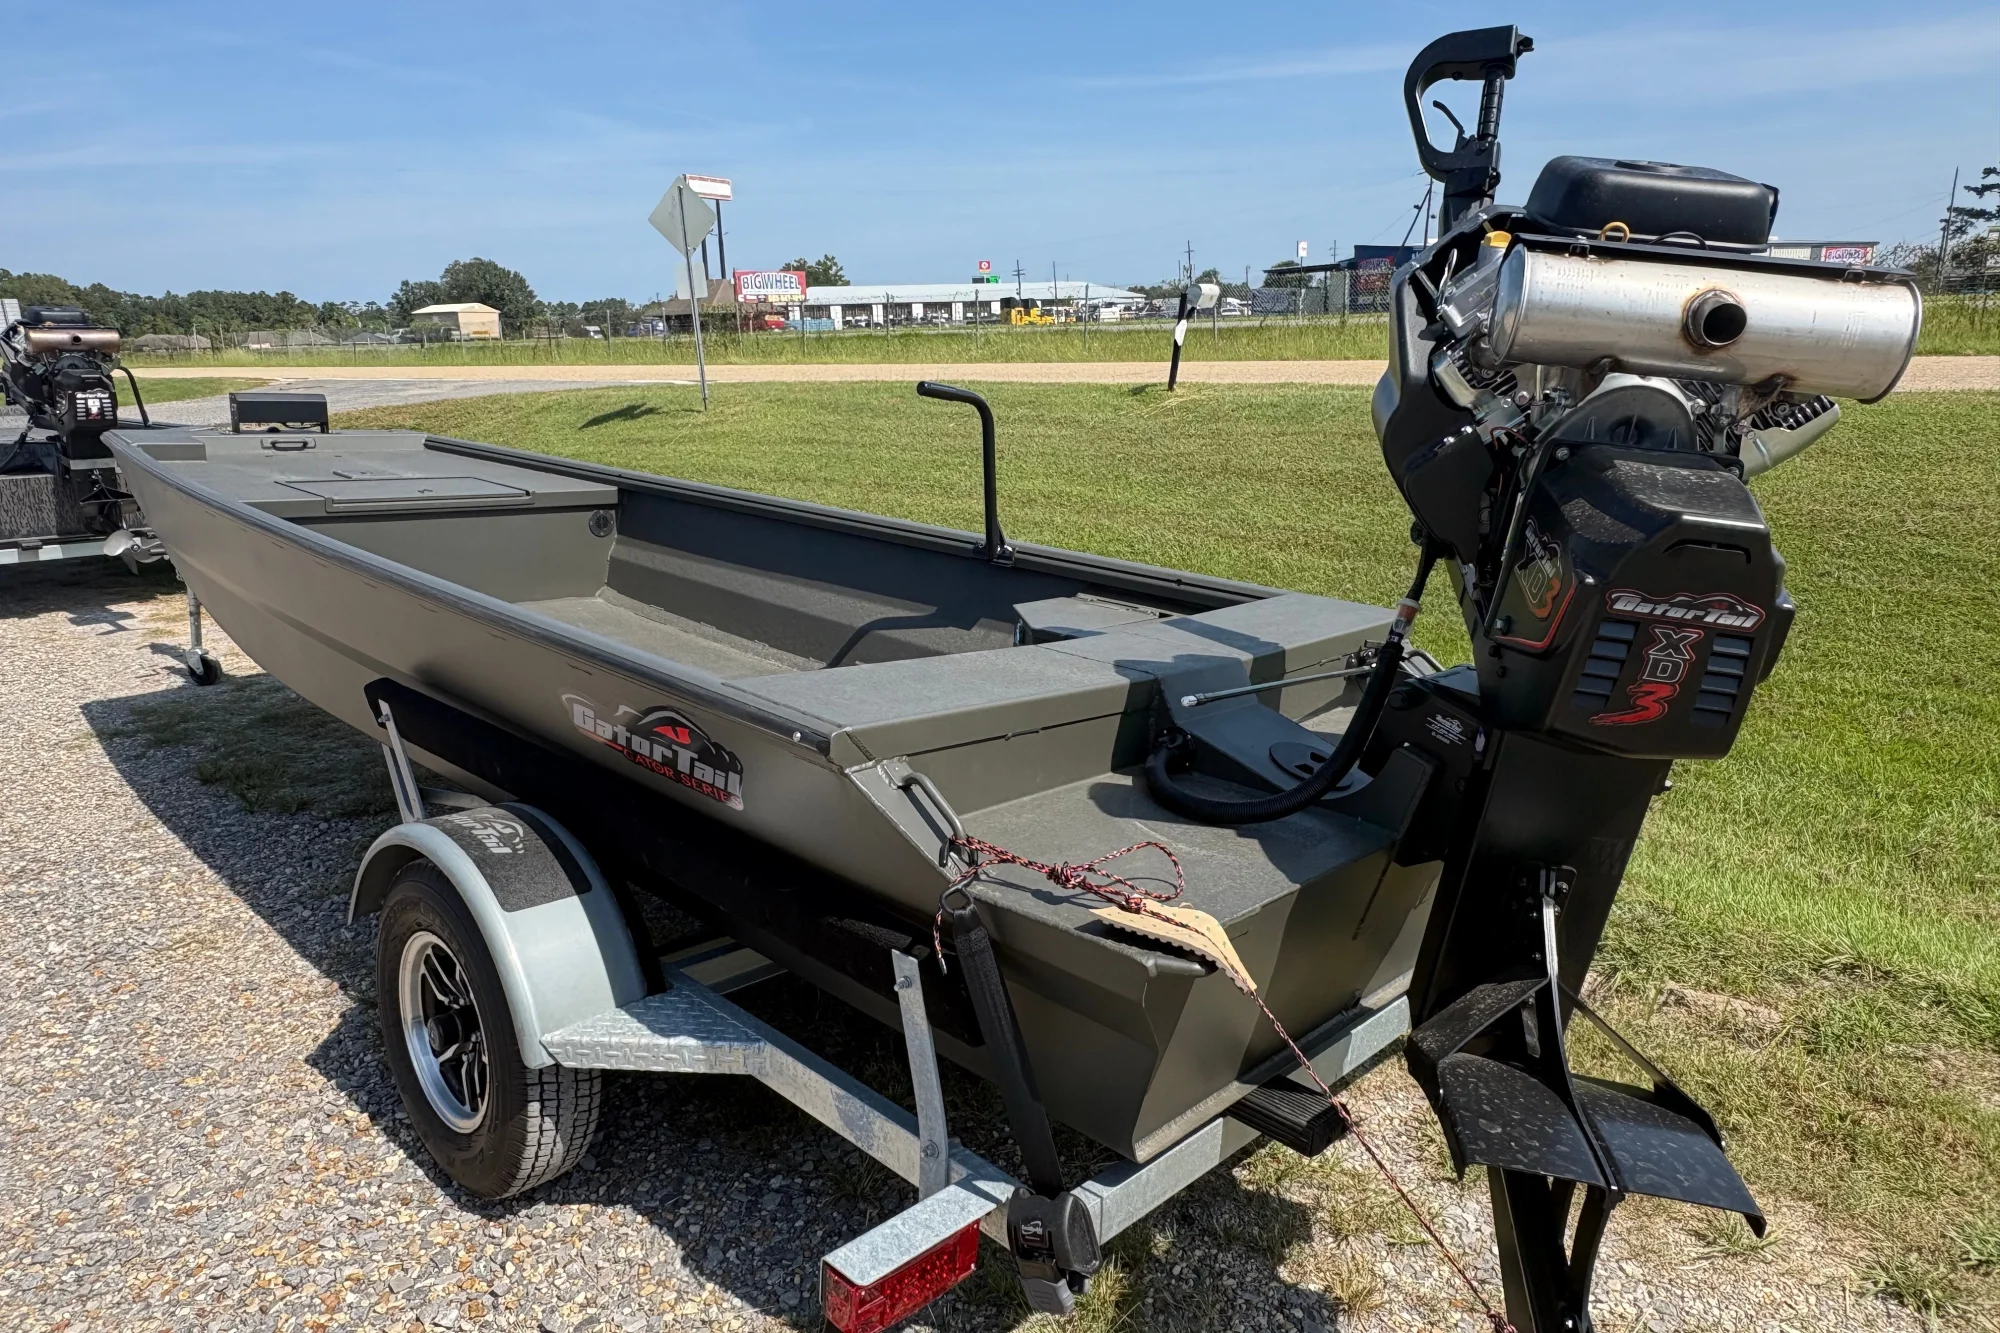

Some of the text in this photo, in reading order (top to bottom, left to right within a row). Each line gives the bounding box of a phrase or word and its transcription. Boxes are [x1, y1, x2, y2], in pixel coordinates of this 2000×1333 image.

[1612, 596, 1759, 628] GatorTail
[572, 703, 741, 797] GatorTail
[622, 747, 742, 808] GATOR SERIES
